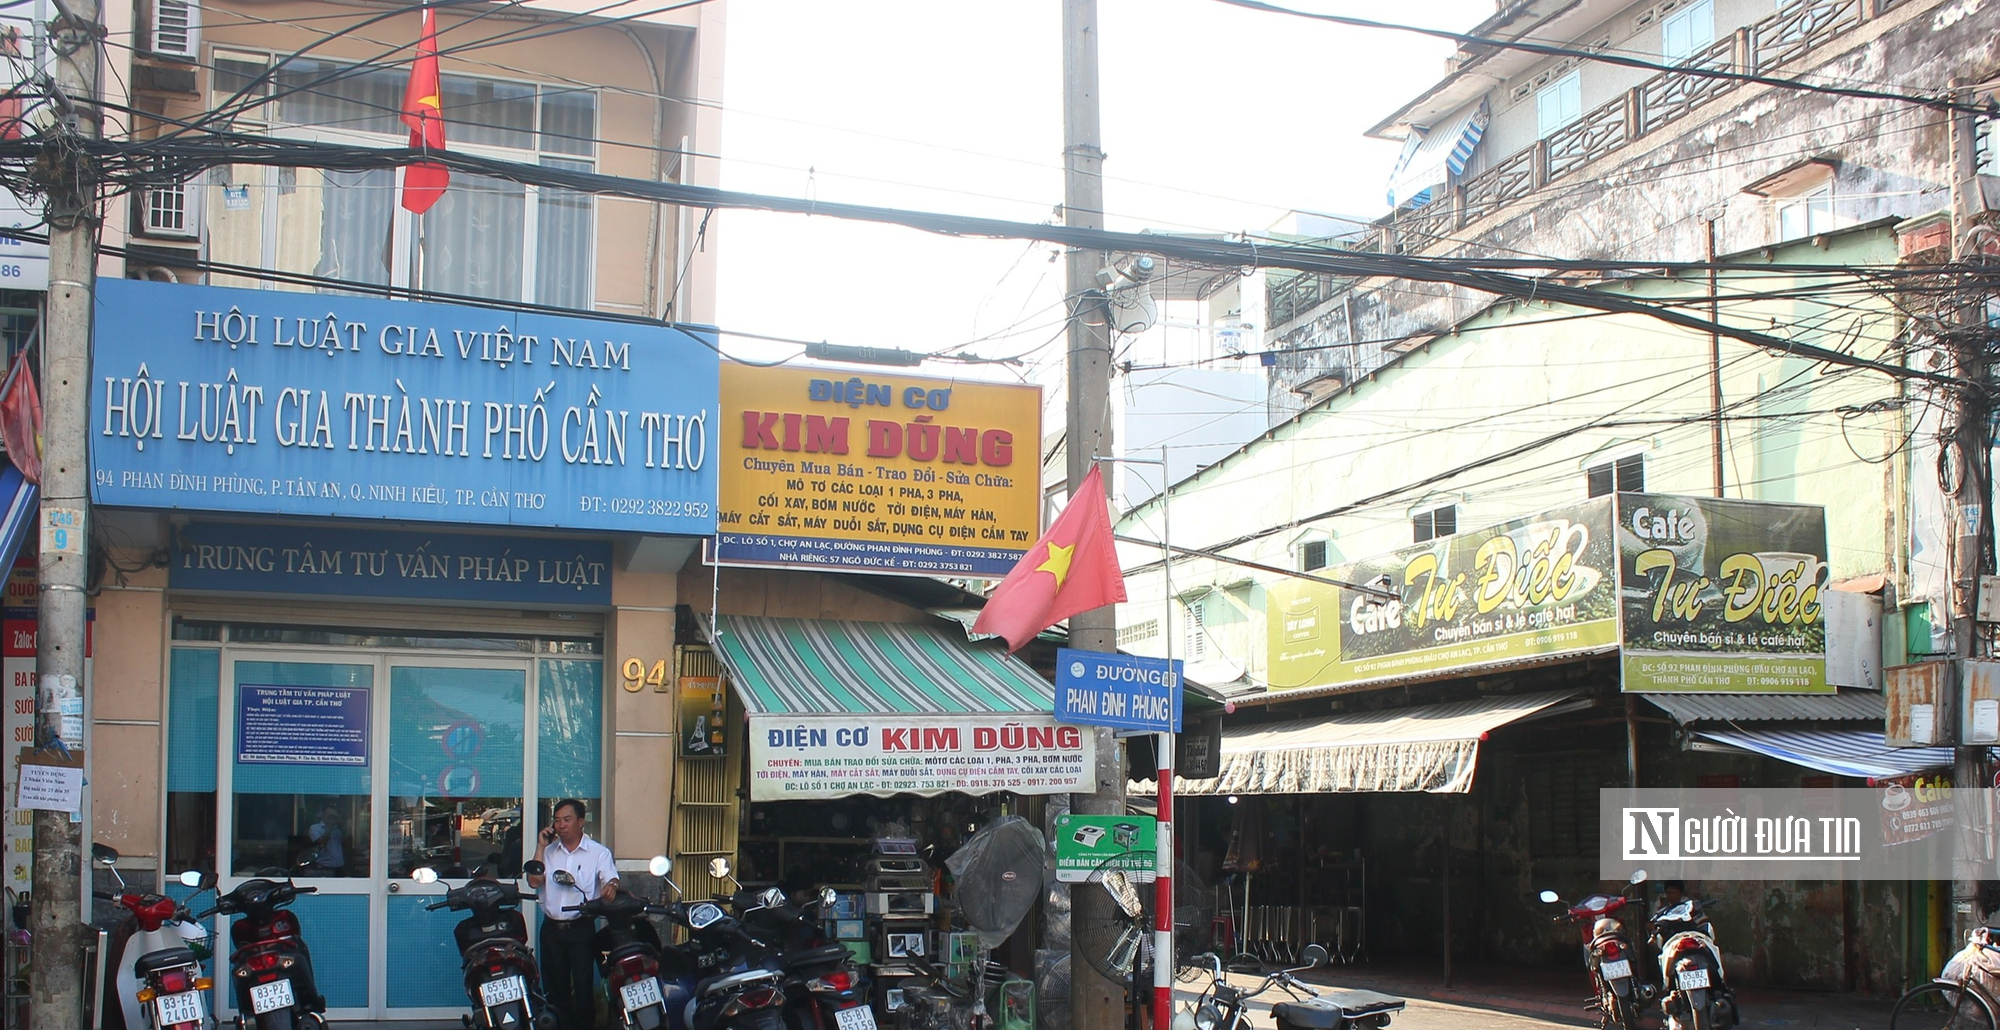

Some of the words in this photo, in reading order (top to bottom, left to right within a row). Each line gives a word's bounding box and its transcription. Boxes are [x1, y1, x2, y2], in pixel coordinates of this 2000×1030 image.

[194, 305, 259, 350] HỘI
[273, 312, 367, 357] LUẬT
[380, 324, 444, 358] GIA
[454, 325, 539, 370] VIỆT
[551, 337, 631, 371] NAM
[809, 377, 892, 408] ĐIỆN
[903, 386, 952, 411] CƠ
[103, 362, 164, 451] HỘI
[178, 367, 264, 455] LUẬT
[275, 387, 334, 449] GIA
[344, 378, 471, 458] THÀNH
[483, 381, 556, 461] PHỐ
[561, 383, 629, 466] CẦN
[640, 409, 707, 471] THƠ
[742, 410, 850, 455] KIM
[866, 415, 1014, 467] DŨNG
[743, 457, 795, 475] Chuyên
[801, 461, 830, 475] Mua
[837, 463, 865, 478] Bán
[875, 466, 907, 481] Trao
[913, 466, 936, 483] Đổi
[946, 468, 971, 485] Sửa
[975, 473, 1013, 488] Chữa:
[96, 469, 114, 487] 94
[122, 471, 164, 489] PHAN
[169, 470, 207, 492] ĐÌNH
[212, 472, 267, 497] PHÙNG,
[350, 484, 366, 501] Q.
[368, 484, 406, 502] NINH
[412, 483, 448, 506] KIỀU,
[455, 489, 476, 506] TP.
[481, 486, 509, 508] CẦN
[515, 492, 546, 510] THƠ
[580, 495, 607, 513] ĐT:
[611, 497, 644, 515] 0292
[647, 499, 681, 517] 3822
[684, 501, 709, 519] 952
[787, 478, 804, 491] MÔ
[811, 480, 827, 492] TƠ
[831, 480, 854, 494] CÁC
[859, 484, 883, 498] LOẠI
[889, 486, 894, 497] 1
[900, 487, 925, 500] PHA,
[927, 490, 934, 499] 3
[939, 490, 964, 504] PHA,
[758, 492, 778, 508] CỐI
[785, 497, 808, 510] XAY,
[812, 499, 837, 511] BƠM
[843, 499, 875, 513] NƯỚC
[887, 502, 906, 515] TỜI
[911, 505, 941, 520] ĐIỆN,
[944, 506, 966, 520] MÁY
[971, 508, 997, 523] HÀN,
[54, 529, 68, 549] 9
[719, 510, 742, 524] MÁY
[749, 510, 771, 526] CẮT
[777, 512, 800, 529] SẮT,
[804, 516, 827, 529] MÁY
[867, 517, 889, 535] SẮT,
[893, 523, 923, 537] DỤNG
[928, 524, 944, 539] CỤ
[949, 525, 976, 541] ĐIỆN
[1010, 530, 1029, 541] TAY
[1632, 507, 1696, 540] Café
[741, 536, 754, 545] LÔ
[778, 538, 797, 549] CHỢ
[799, 540, 812, 549] AN
[814, 541, 833, 552] LẠC,
[834, 540, 866, 552] ĐƯỜNG
[867, 544, 891, 554] PHAN
[892, 543, 913, 555] ĐÌNH
[914, 545, 943, 556] PHÙNG
[951, 549, 965, 558] ĐT:
[966, 551, 985, 559] 0292
[987, 551, 1007, 560] 3827
[779, 552, 798, 562] NHÀ
[801, 553, 828, 563] RIÊNG:
[829, 555, 839, 563] 57
[842, 555, 862, 565] NGÔ
[863, 555, 883, 566] ĐỨC
[884, 556, 896, 567] KẾ
[902, 560, 917, 568] ĐT:
[918, 561, 938, 569] 0292
[939, 562, 958, 570] 3753
[959, 563, 973, 571] 821
[182, 545, 275, 573] TRUNG
[282, 541, 343, 575] TÂM
[351, 549, 388, 578] TƯ
[396, 541, 450, 580] VẤN
[458, 549, 530, 584] PHÁP
[538, 555, 605, 591] LUẬT
[1634, 548, 1710, 624] Tư
[1472, 618, 1493, 632] bán
[1528, 606, 1554, 625] café
[1653, 631, 1697, 645] Chuyên
[1700, 631, 1722, 644] bán
[1760, 633, 1785, 646] café
[622, 657, 669, 693] 94
[1096, 663, 1161, 685] ĐƯỜNG
[1760, 677, 1779, 686] 0906
[1780, 677, 1794, 686] 919
[1795, 677, 1810, 686] 118
[1066, 688, 1097, 714] PHAN
[1101, 685, 1126, 717] ĐÌNH
[1132, 689, 1169, 721] PHÙNG
[768, 725, 827, 751] ĐIỆN
[836, 726, 869, 747] CƠ
[881, 727, 960, 750] KIM
[973, 722, 1081, 750] DŨNG
[166, 1006, 197, 1023] 2400
